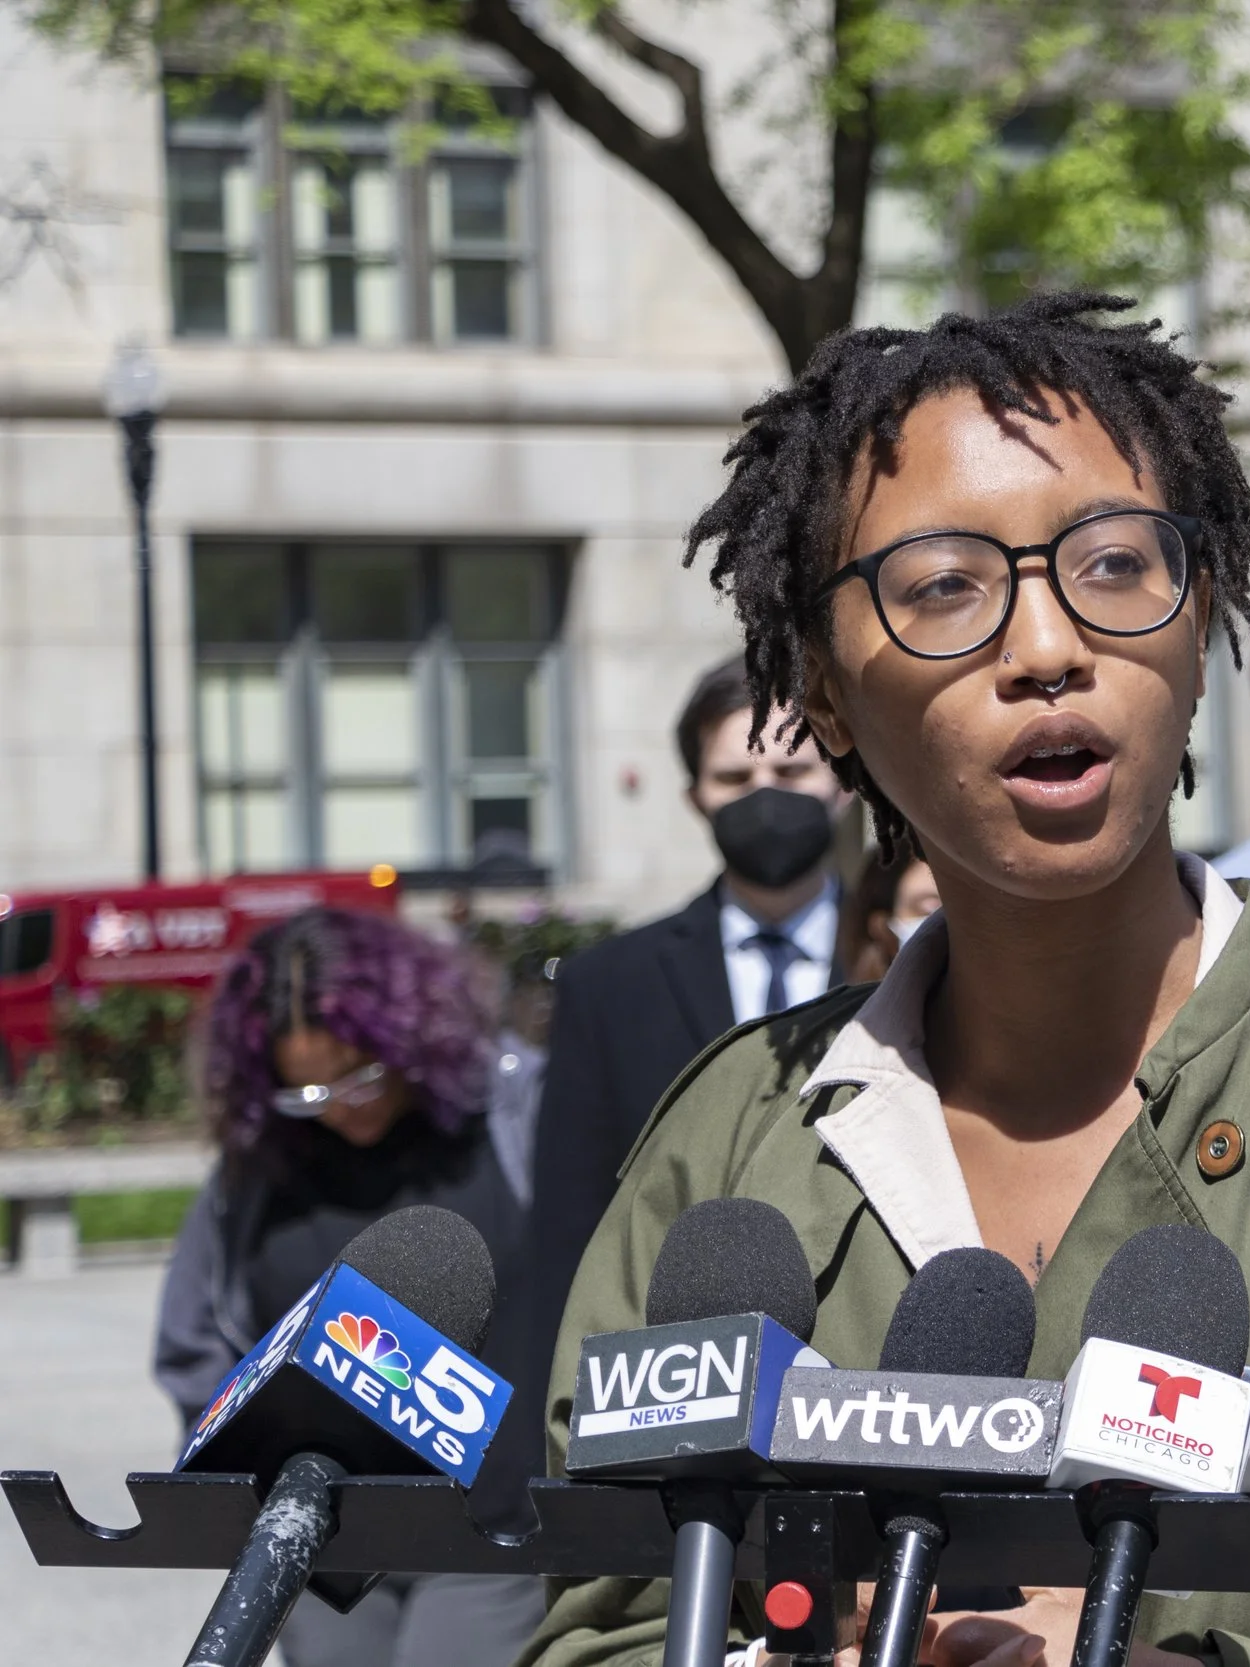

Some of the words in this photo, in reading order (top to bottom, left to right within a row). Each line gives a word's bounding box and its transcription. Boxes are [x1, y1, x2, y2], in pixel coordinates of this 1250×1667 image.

[258, 1282, 320, 1370] 5
[183, 1345, 290, 1461] NEWS
[313, 1342, 466, 1466] NEWS
[414, 1345, 495, 1434] 5
[588, 1335, 748, 1412] WGN
[629, 1405, 687, 1427] NEWS
[791, 1391, 982, 1447] wttw
[1098, 1430, 1211, 1471] CHICAGO
[1101, 1413, 1214, 1457] NOTICIERO
